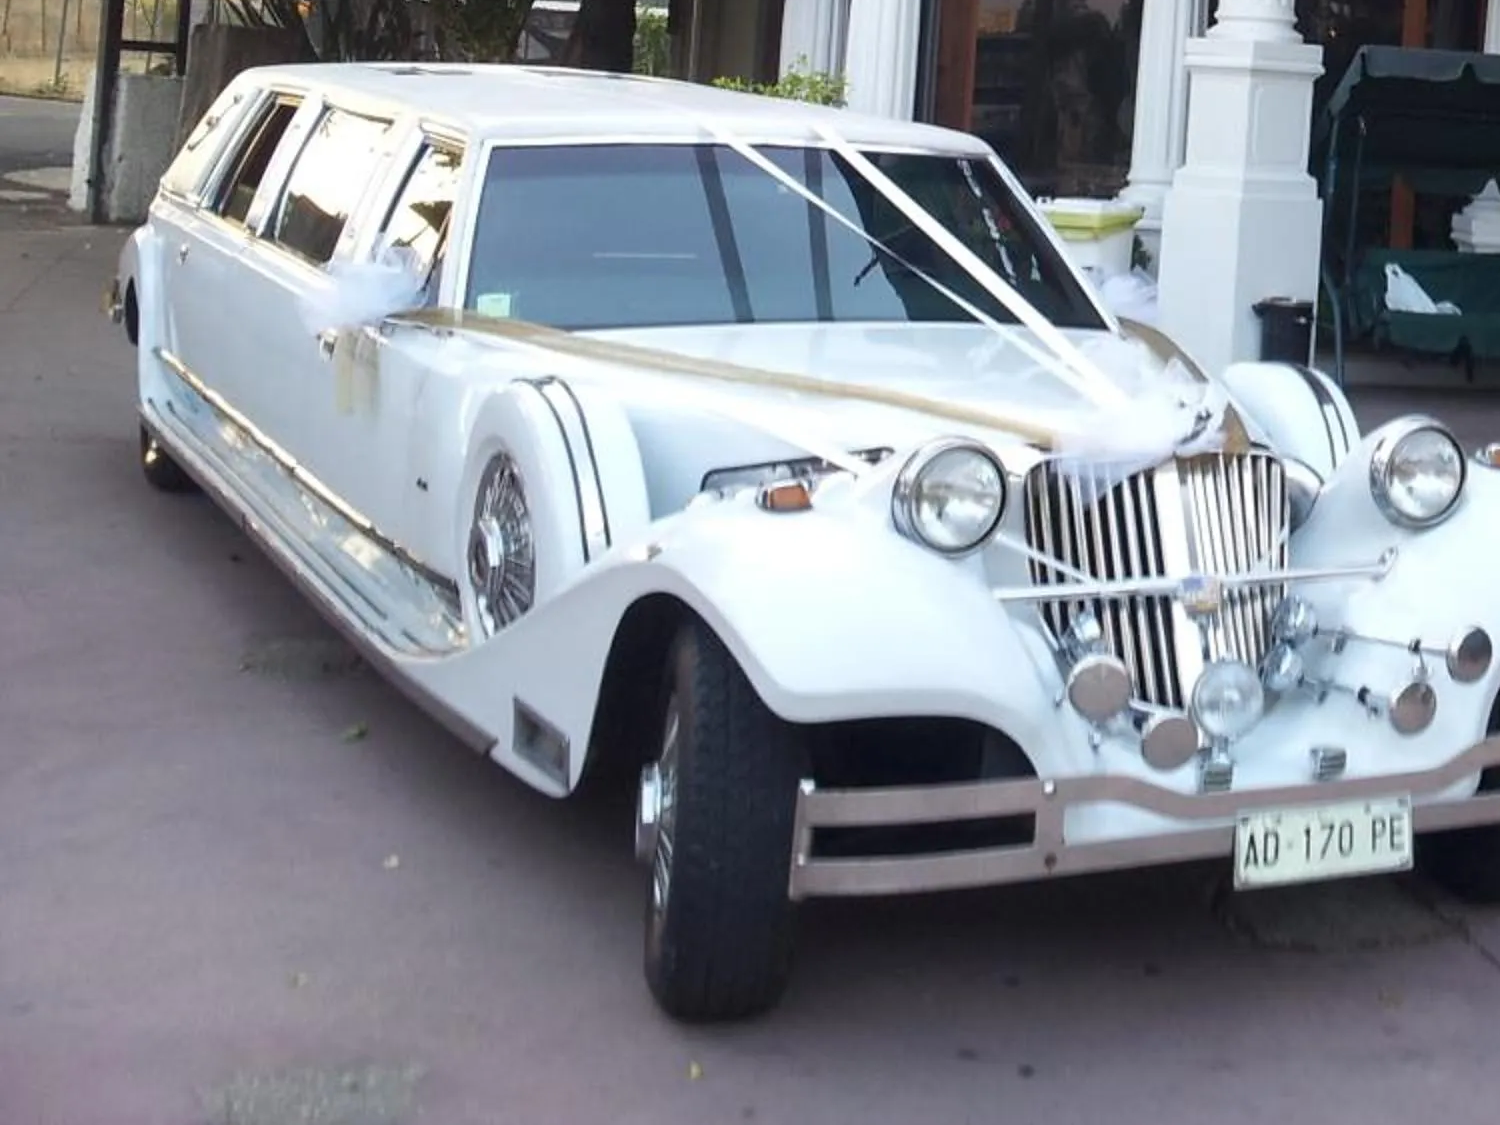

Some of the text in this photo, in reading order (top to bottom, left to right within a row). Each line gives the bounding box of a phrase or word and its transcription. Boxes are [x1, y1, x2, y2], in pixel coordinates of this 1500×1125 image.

[1243, 814, 1406, 869] AD 170 PE
